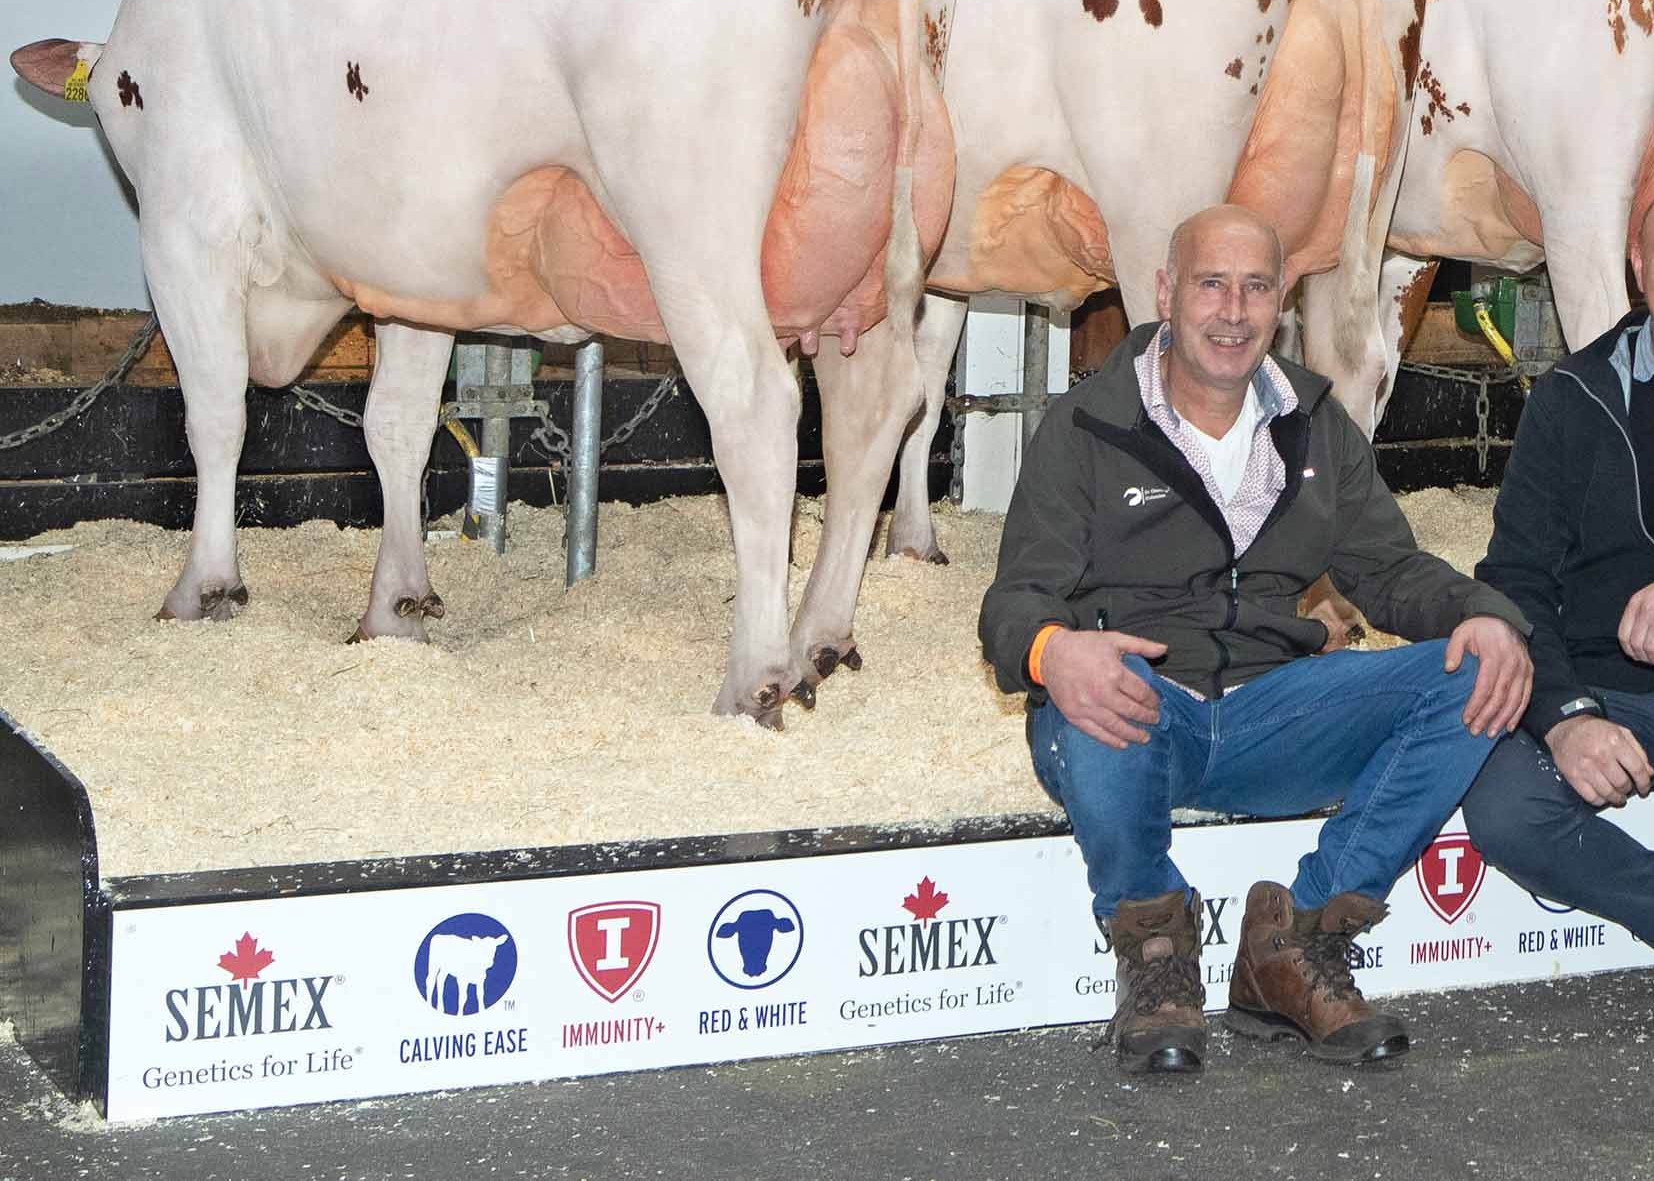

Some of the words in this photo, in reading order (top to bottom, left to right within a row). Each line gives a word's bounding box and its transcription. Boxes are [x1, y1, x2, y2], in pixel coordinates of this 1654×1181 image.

[859, 916, 998, 978] SEMEX
[1410, 937, 1493, 964] IMMUNITY+
[1518, 931, 1544, 953] RED
[1550, 929, 1559, 950] &
[1564, 924, 1605, 947] WHITE
[165, 976, 334, 1043] SEMEX
[699, 1006, 732, 1034] RED
[739, 1008, 748, 1030] &
[755, 1001, 807, 1028] WHITE
[840, 993, 931, 1021] Genetics
[939, 989, 968, 1011] for
[976, 985, 1014, 1006] Life
[400, 1035, 477, 1063] CALVING
[484, 1028, 528, 1056] EASE
[562, 1017, 665, 1048] IMMUNITY+
[142, 1060, 253, 1089] Genetics
[261, 1055, 298, 1078] for
[307, 1048, 354, 1073] Life
